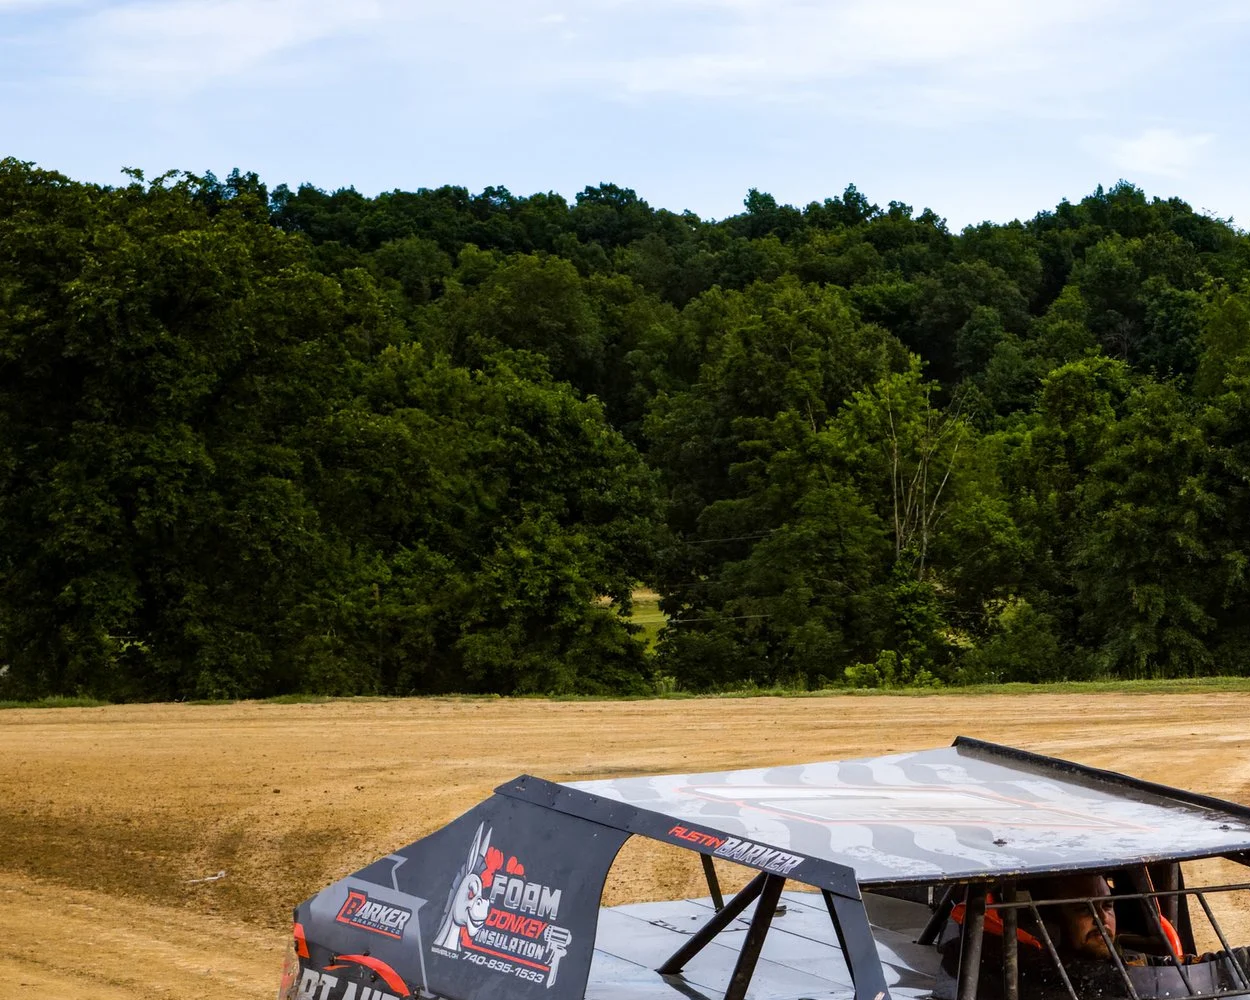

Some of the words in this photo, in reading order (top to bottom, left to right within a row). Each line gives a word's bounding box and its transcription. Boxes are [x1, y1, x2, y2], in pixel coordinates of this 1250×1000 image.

[668, 825, 726, 849] AUSTIN
[714, 836, 805, 874] BARKER
[336, 891, 411, 930] BARKER
[489, 874, 561, 920] FOAM
[485, 908, 547, 939] DONKEY
[475, 928, 545, 960] INSULATION
[462, 951, 545, 983] 740-835-1533
